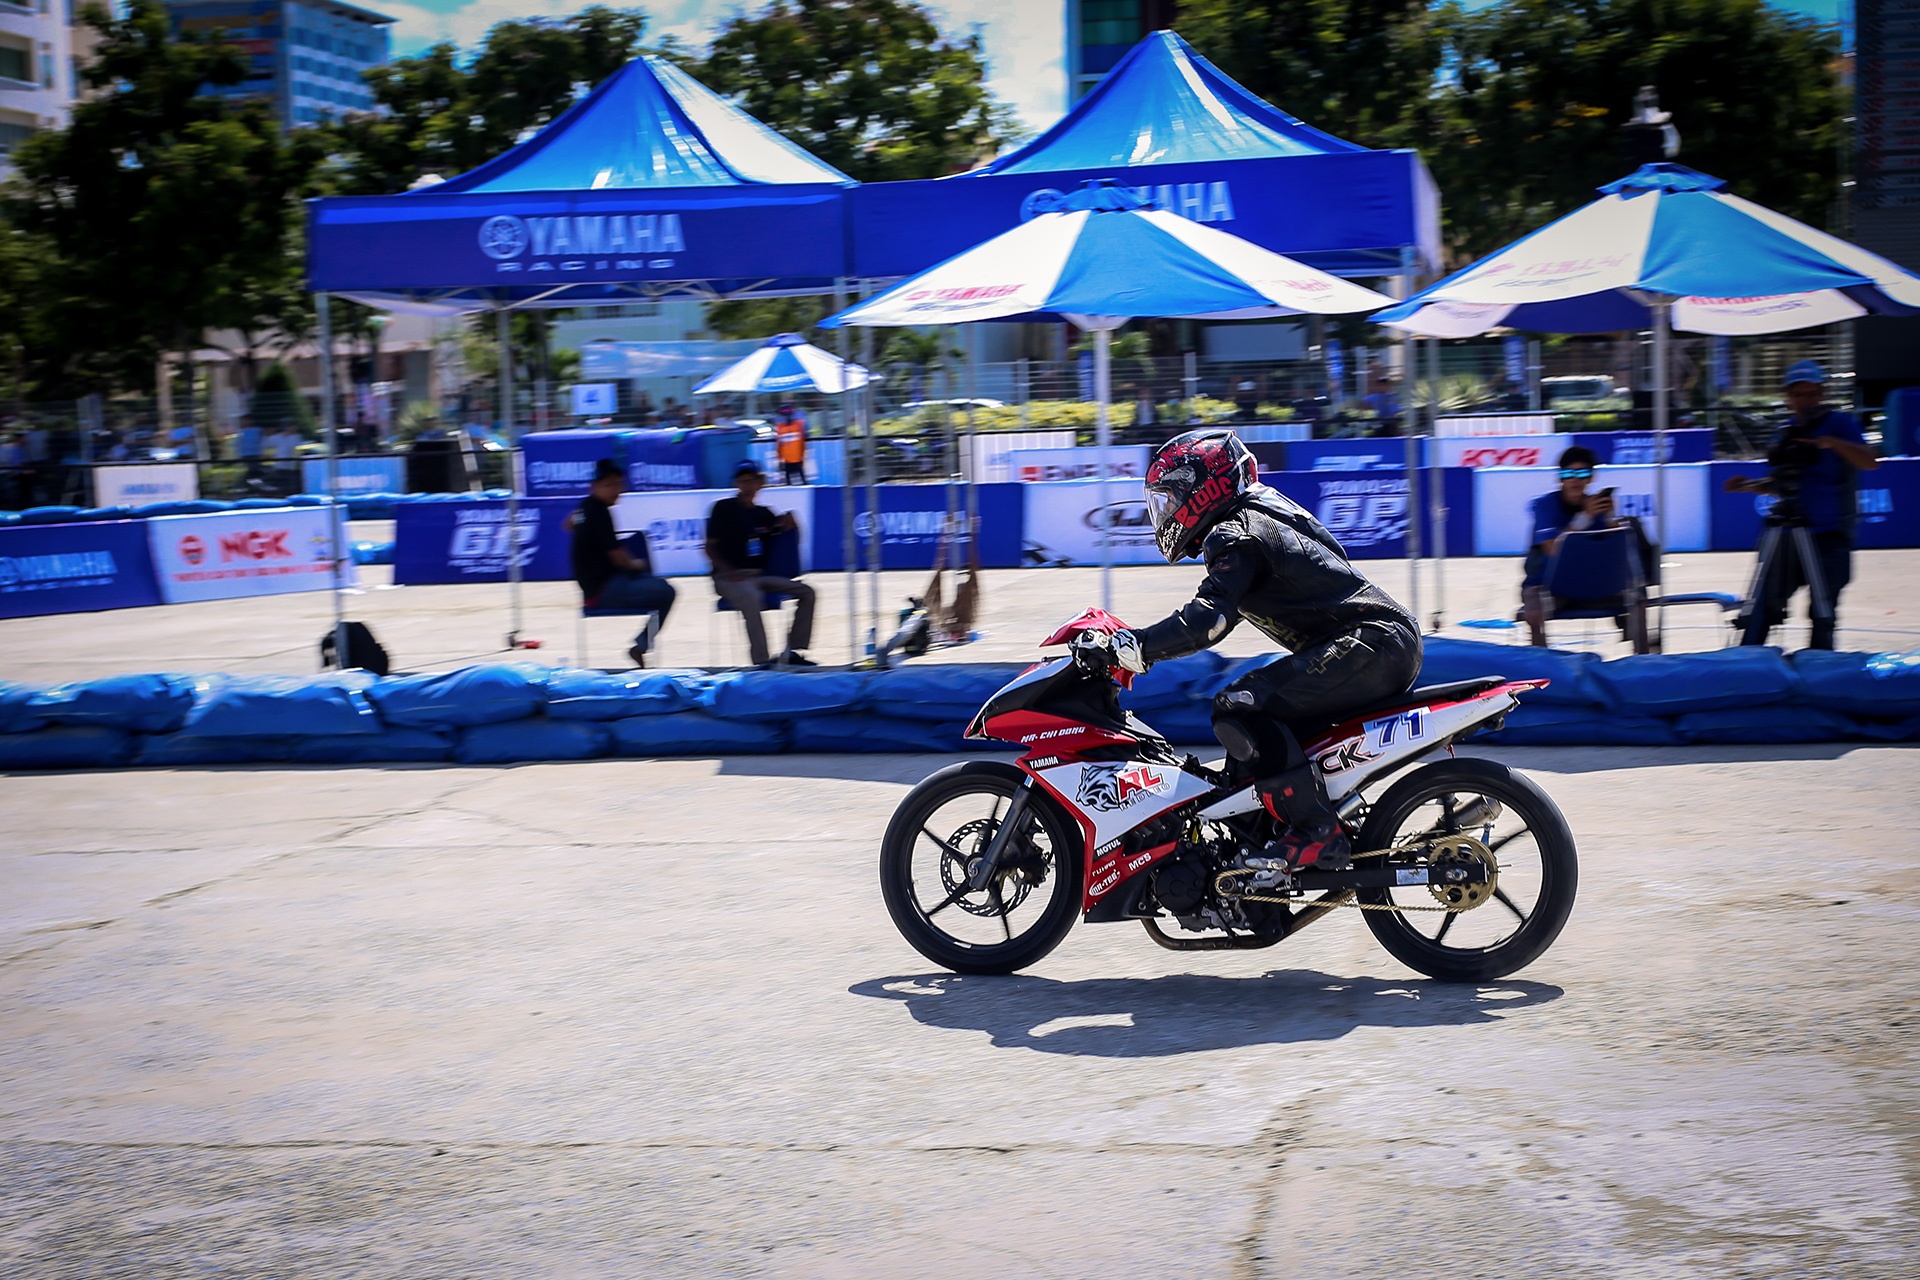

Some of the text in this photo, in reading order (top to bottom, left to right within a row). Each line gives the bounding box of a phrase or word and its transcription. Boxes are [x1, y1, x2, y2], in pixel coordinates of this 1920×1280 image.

[525, 213, 686, 256] YAMAHA
[496, 259, 676, 272] RACING
[880, 510, 973, 535] YAMAHA
[216, 529, 294, 563] NGK
[1373, 708, 1424, 748] 71
[1029, 755, 1059, 770] YAMAHA
[1096, 838, 1122, 857] MOTUL
